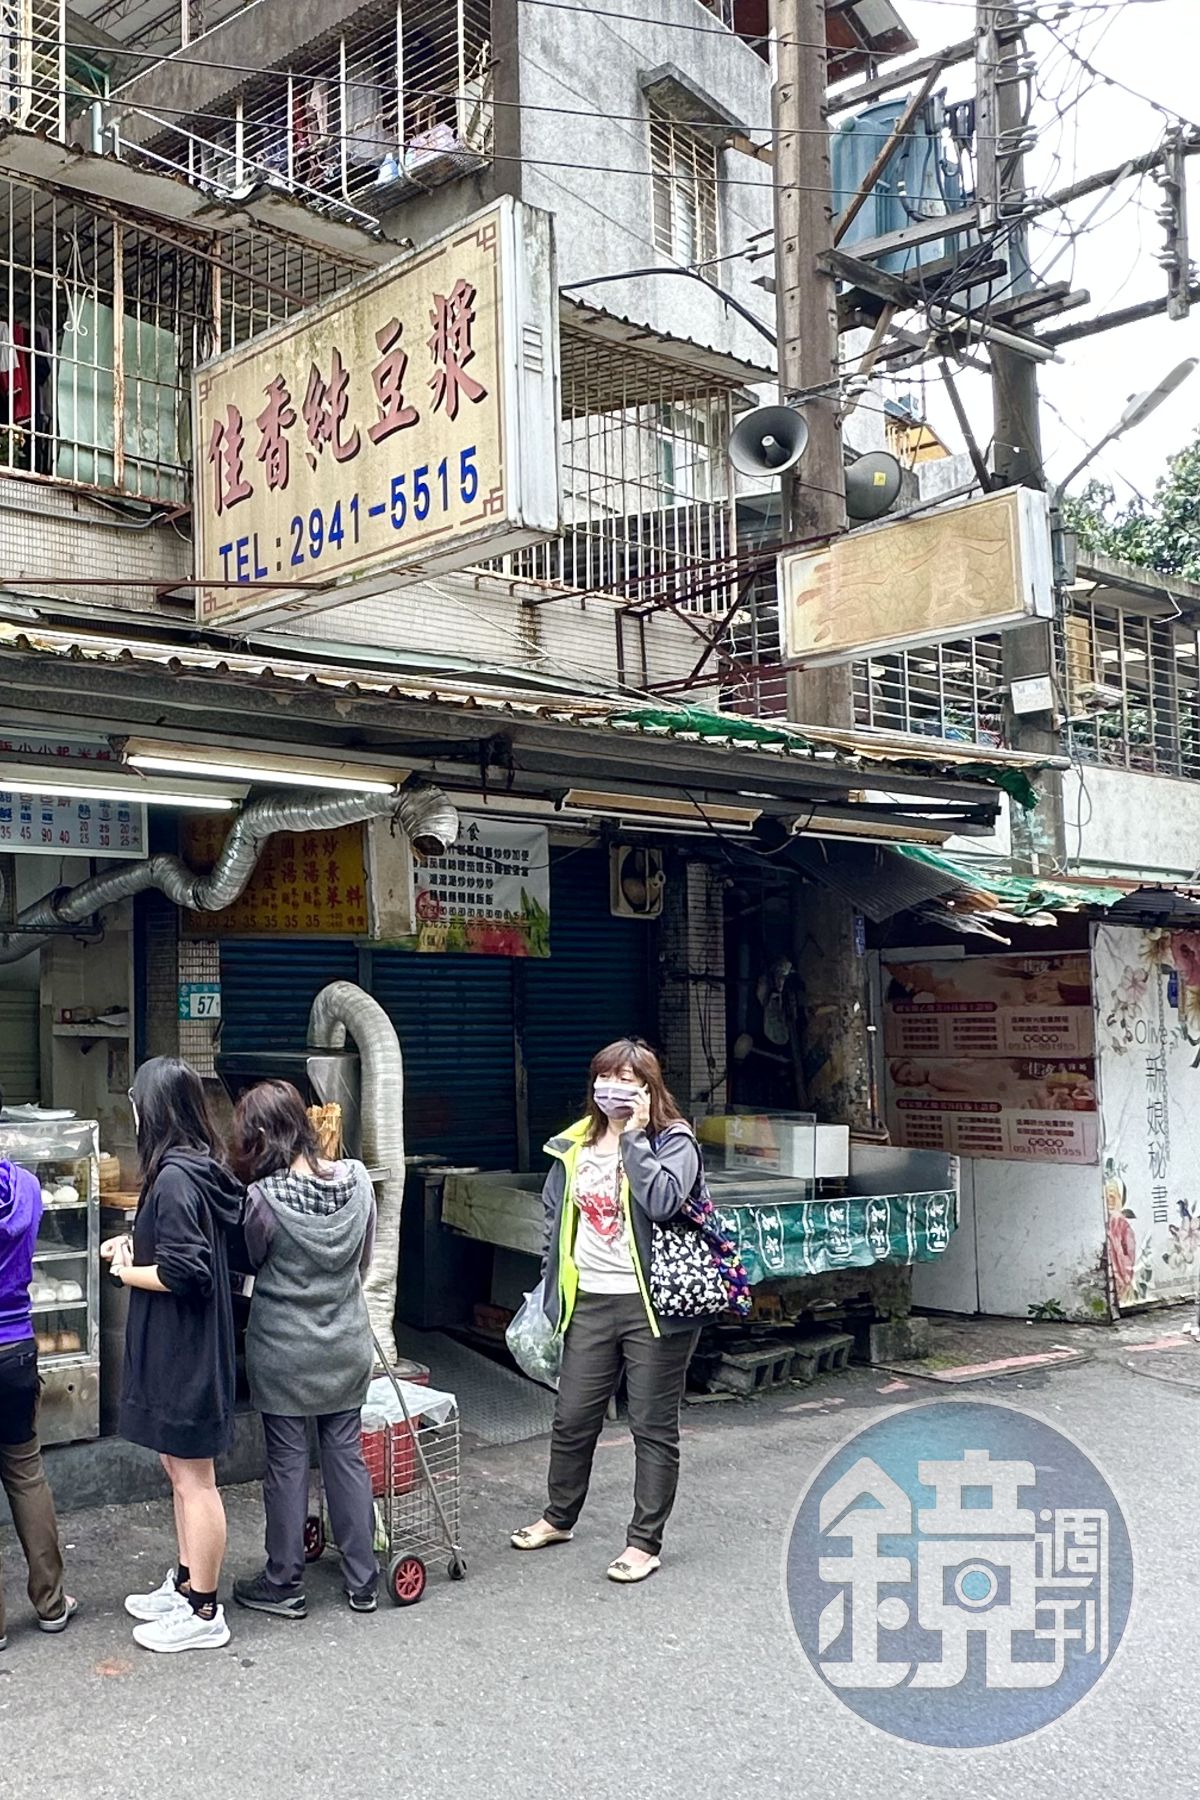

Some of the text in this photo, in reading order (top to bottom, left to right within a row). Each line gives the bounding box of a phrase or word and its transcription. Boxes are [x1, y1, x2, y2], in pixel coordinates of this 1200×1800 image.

[207, 278, 489, 516] 佳香純豆漿
[288, 445, 479, 567] 2941-5515
[20, 826, 32, 840] 45
[284, 914, 299, 928] 35
[305, 914, 320, 928] 35
[197, 995, 215, 1015] 57
